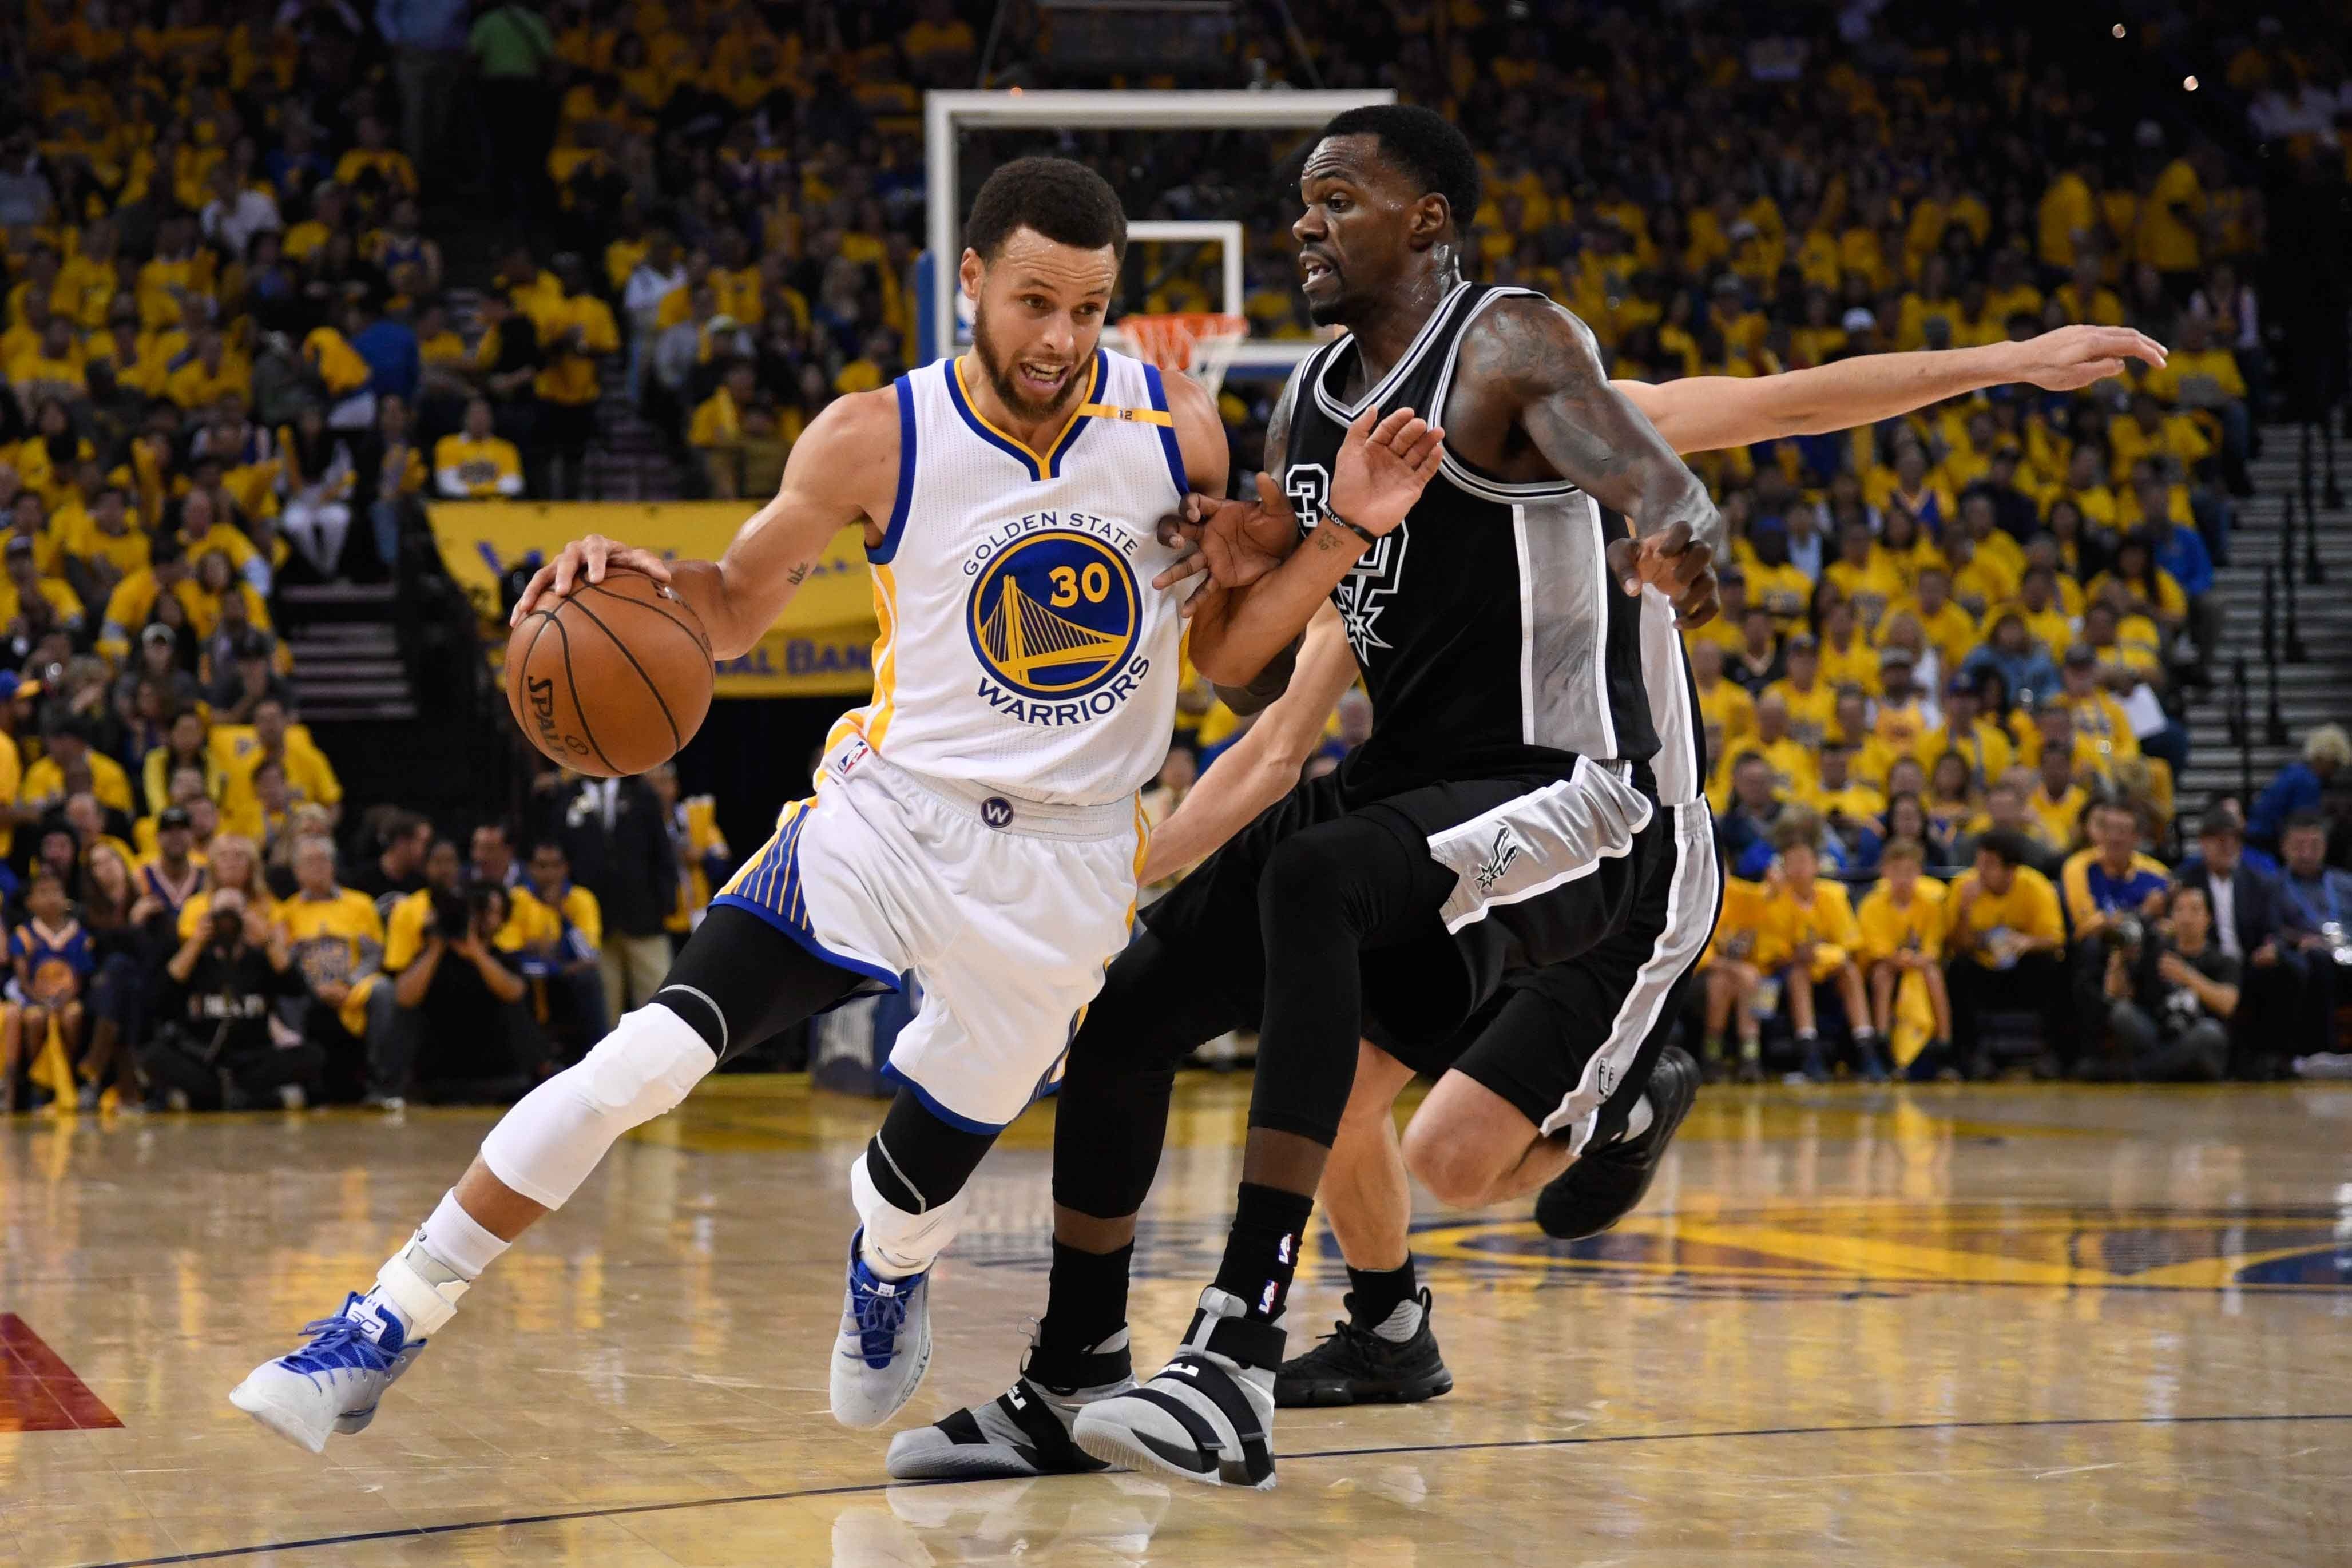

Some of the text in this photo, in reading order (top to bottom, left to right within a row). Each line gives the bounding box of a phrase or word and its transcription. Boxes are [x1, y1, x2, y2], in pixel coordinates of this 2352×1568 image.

[963, 511, 1138, 576] GOLDEN STATE
[1048, 562, 1110, 608] 30
[786, 637, 872, 676] BAN
[977, 654, 1150, 726] WARRIORS
[987, 803, 1010, 823] W
